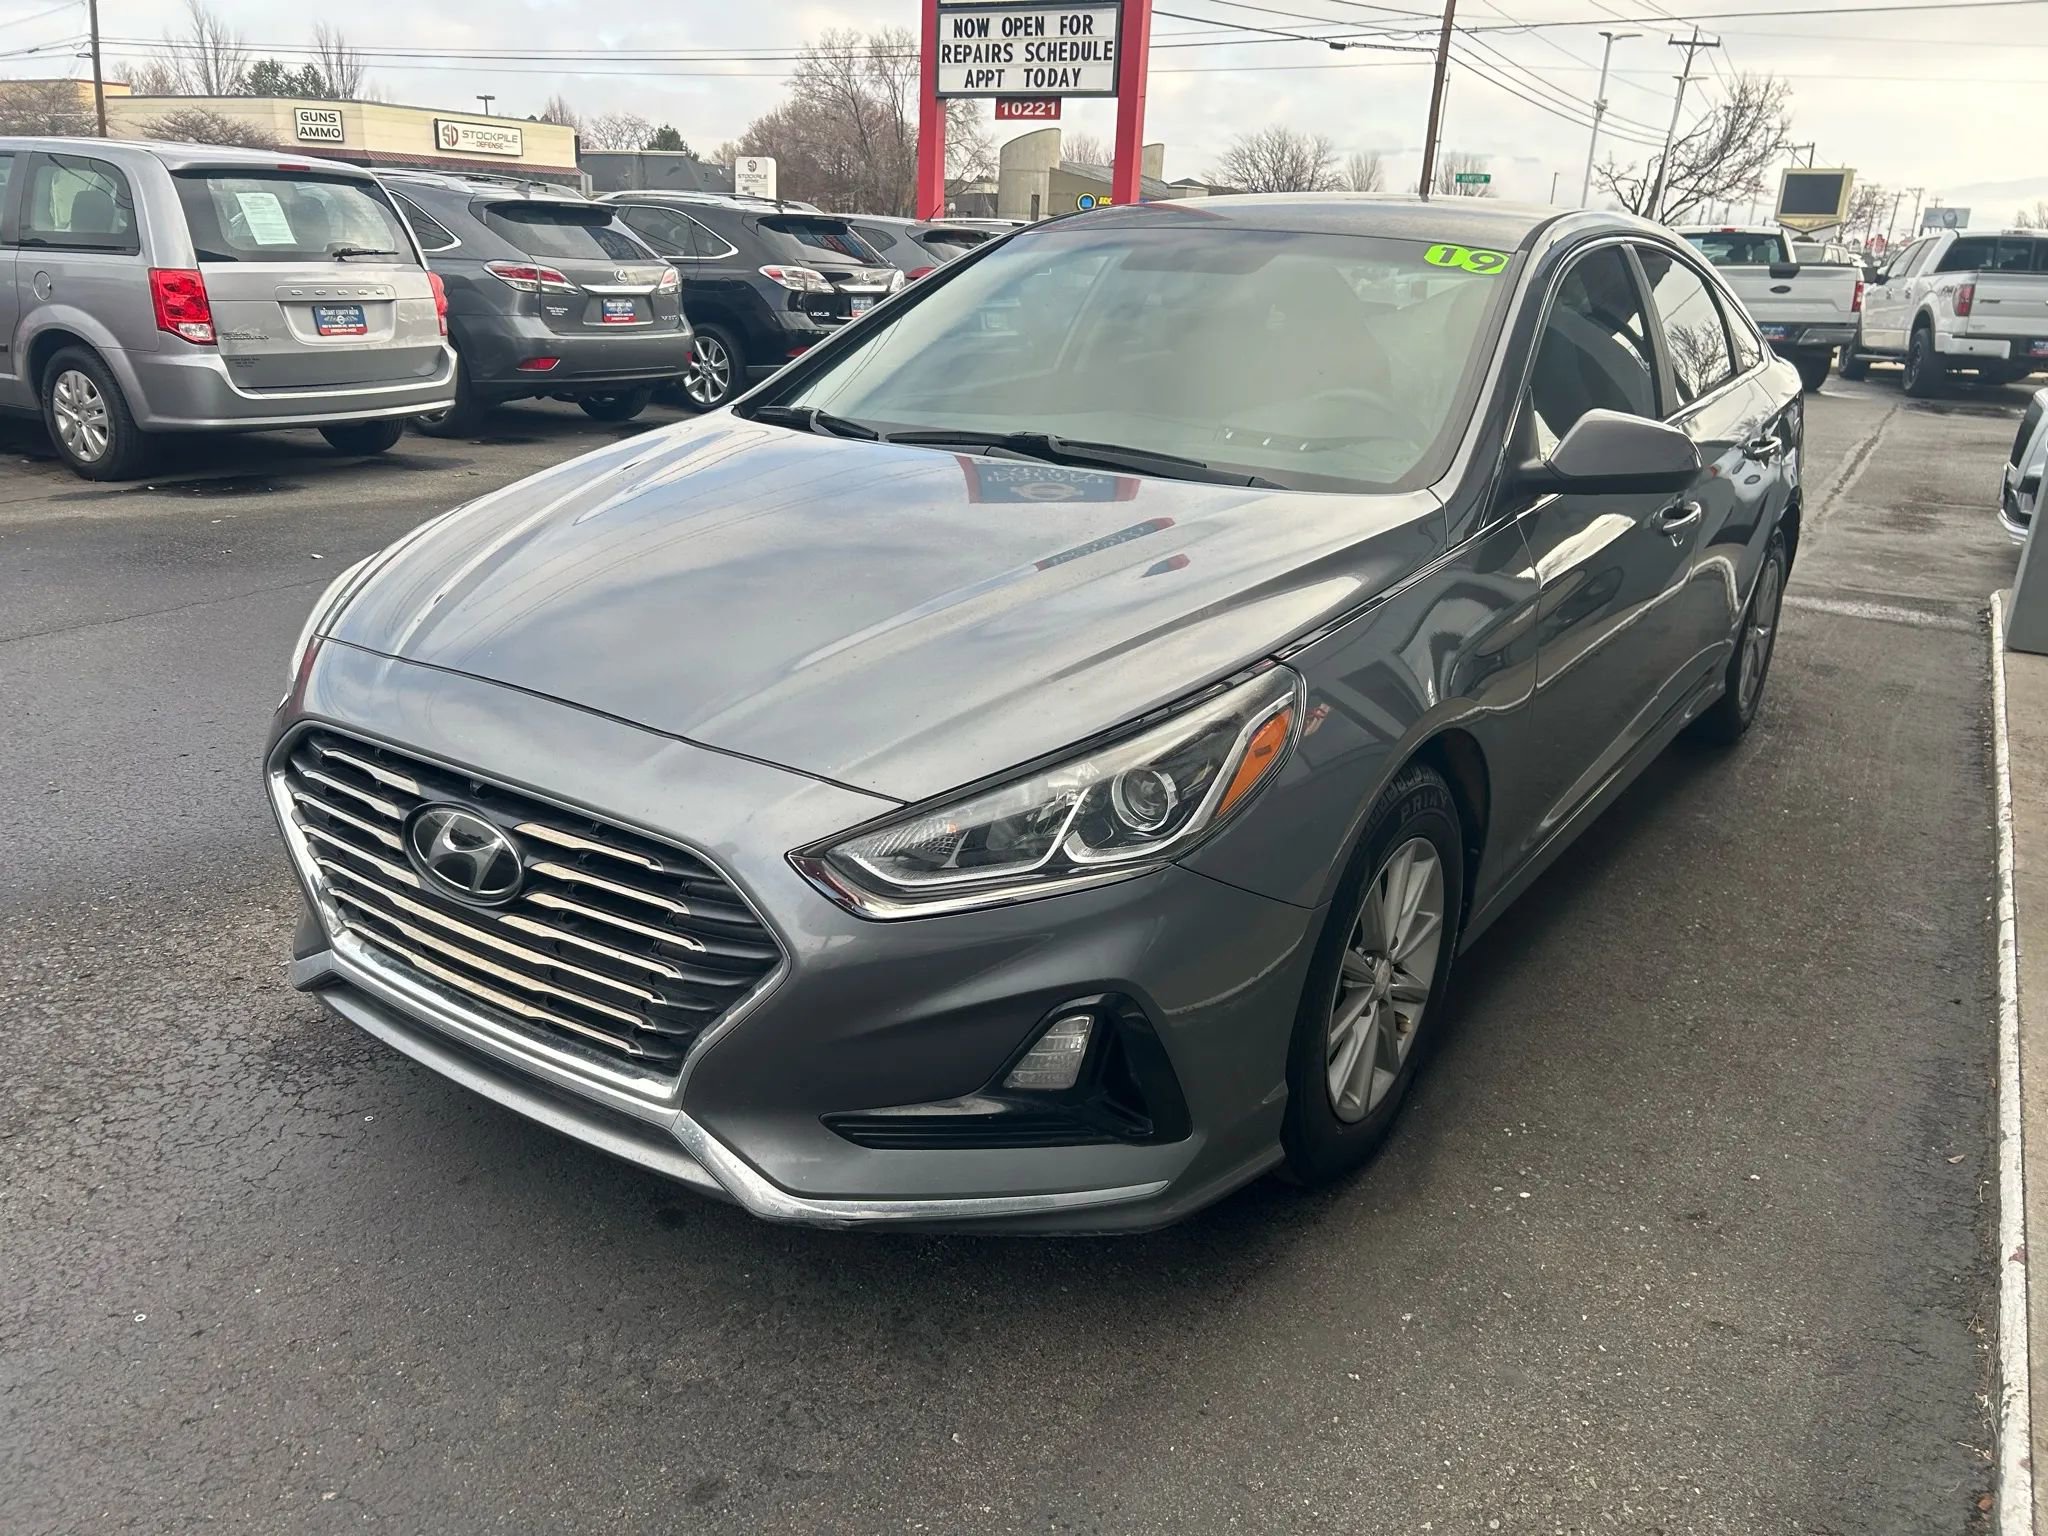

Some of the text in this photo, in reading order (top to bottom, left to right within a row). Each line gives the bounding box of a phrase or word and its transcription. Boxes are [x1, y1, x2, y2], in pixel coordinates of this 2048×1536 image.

[953, 14, 1094, 38] NOW OPEN FOR
[942, 41, 1113, 63] REPAIRS SCHEDULE
[964, 68, 1082, 88] APPT TODAY
[1001, 102, 1056, 116] 10221
[300, 111, 337, 123] GUNS
[299, 127, 341, 138] AMMO
[461, 129, 518, 144] STOCKPILE
[476, 142, 504, 150] DEFENSE
[1439, 246, 1505, 272] 19
